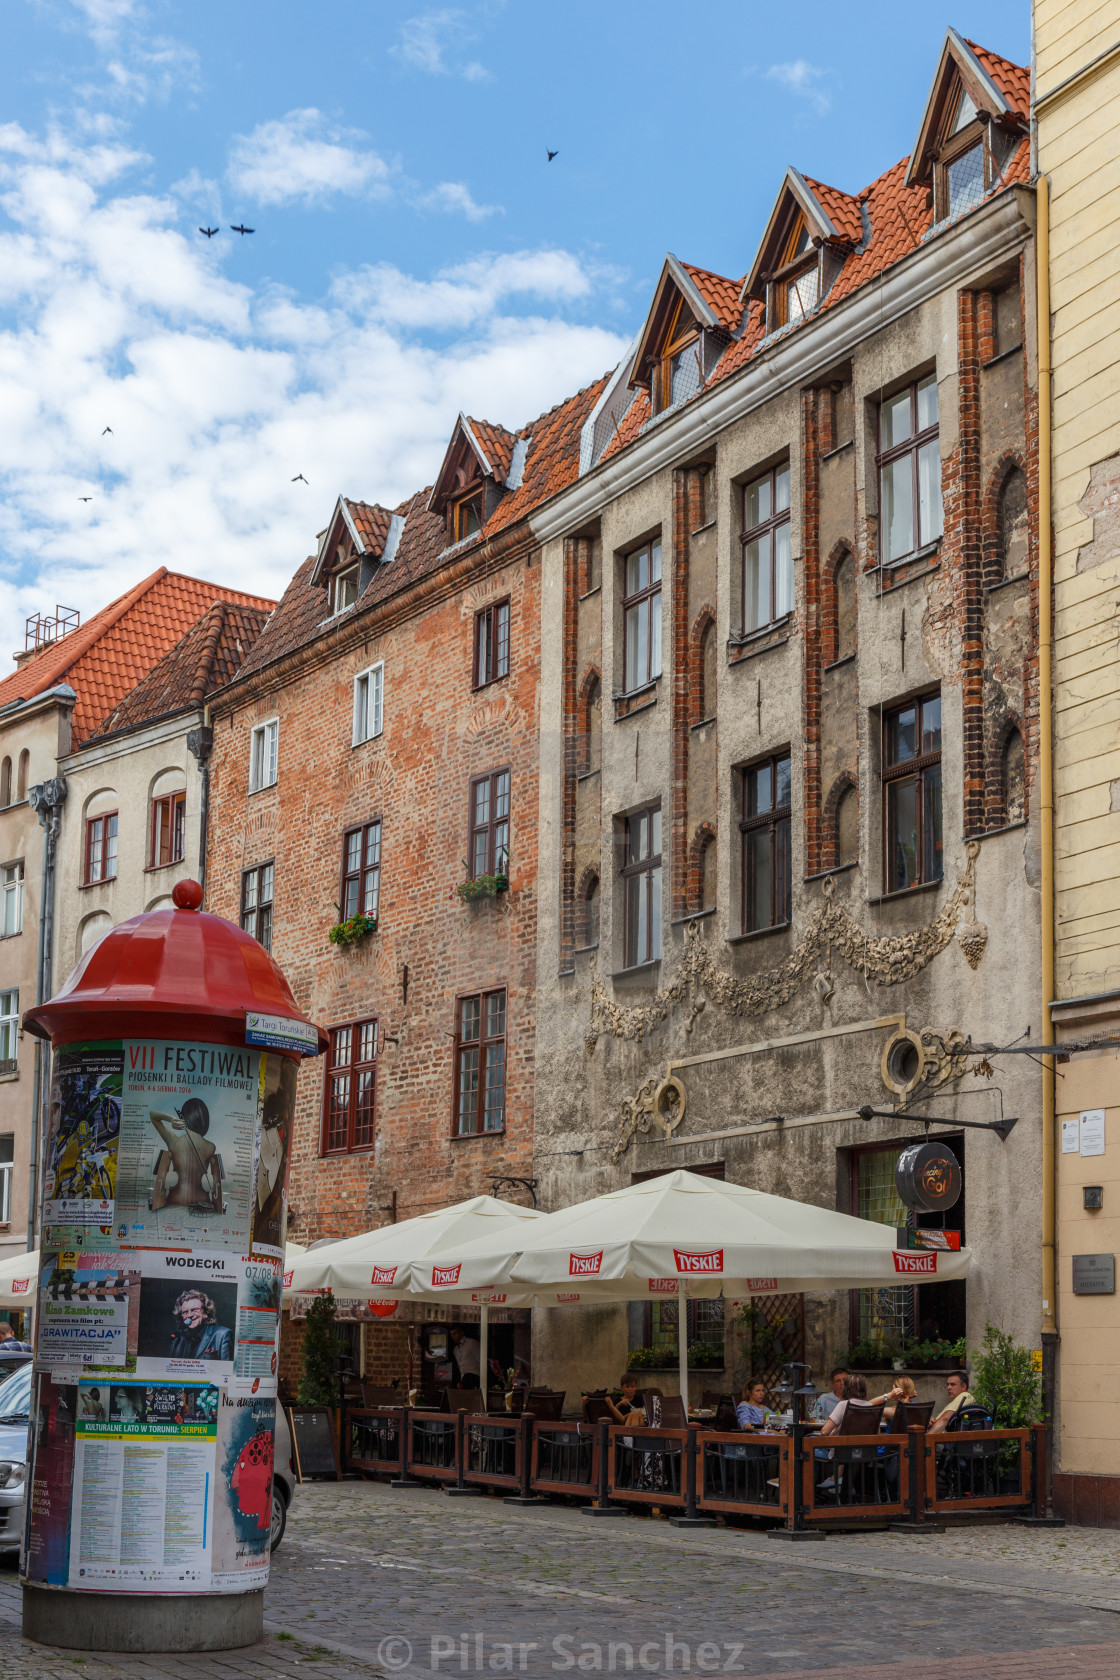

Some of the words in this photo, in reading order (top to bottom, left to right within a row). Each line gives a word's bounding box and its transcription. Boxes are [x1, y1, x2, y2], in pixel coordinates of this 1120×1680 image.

[261, 1018, 277, 1031] Targi
[279, 1022, 304, 1035] Toruńskie
[129, 1046, 156, 1070] VII
[164, 1047, 254, 1079] FESTIWAL
[128, 1071, 167, 1082] PIOSENKI
[170, 1074, 173, 1083] I
[176, 1074, 212, 1086] BALLADY
[215, 1077, 252, 1091] FILMOWEJ
[128, 1083, 145, 1092] TORUŃ,
[178, 1086, 192, 1094] 2016
[166, 1257, 225, 1269] WODECKI
[571, 1257, 600, 1273] TYSKIE
[677, 1253, 721, 1270] TYSKIE
[896, 1255, 934, 1271] TYSKIE
[246, 1266, 271, 1280] 07/08
[374, 1270, 395, 1283] TYSKIE
[434, 1269, 458, 1283] TYSKIE
[45, 1302, 63, 1315] Kino
[64, 1306, 115, 1316] Zamkowe
[222, 1393, 234, 1407] Na
[85, 1423, 122, 1432] KULTURALNE
[124, 1424, 139, 1432] LATO
[149, 1425, 179, 1433] TORUNIU:
[181, 1426, 207, 1434] SIERPIEŃ
